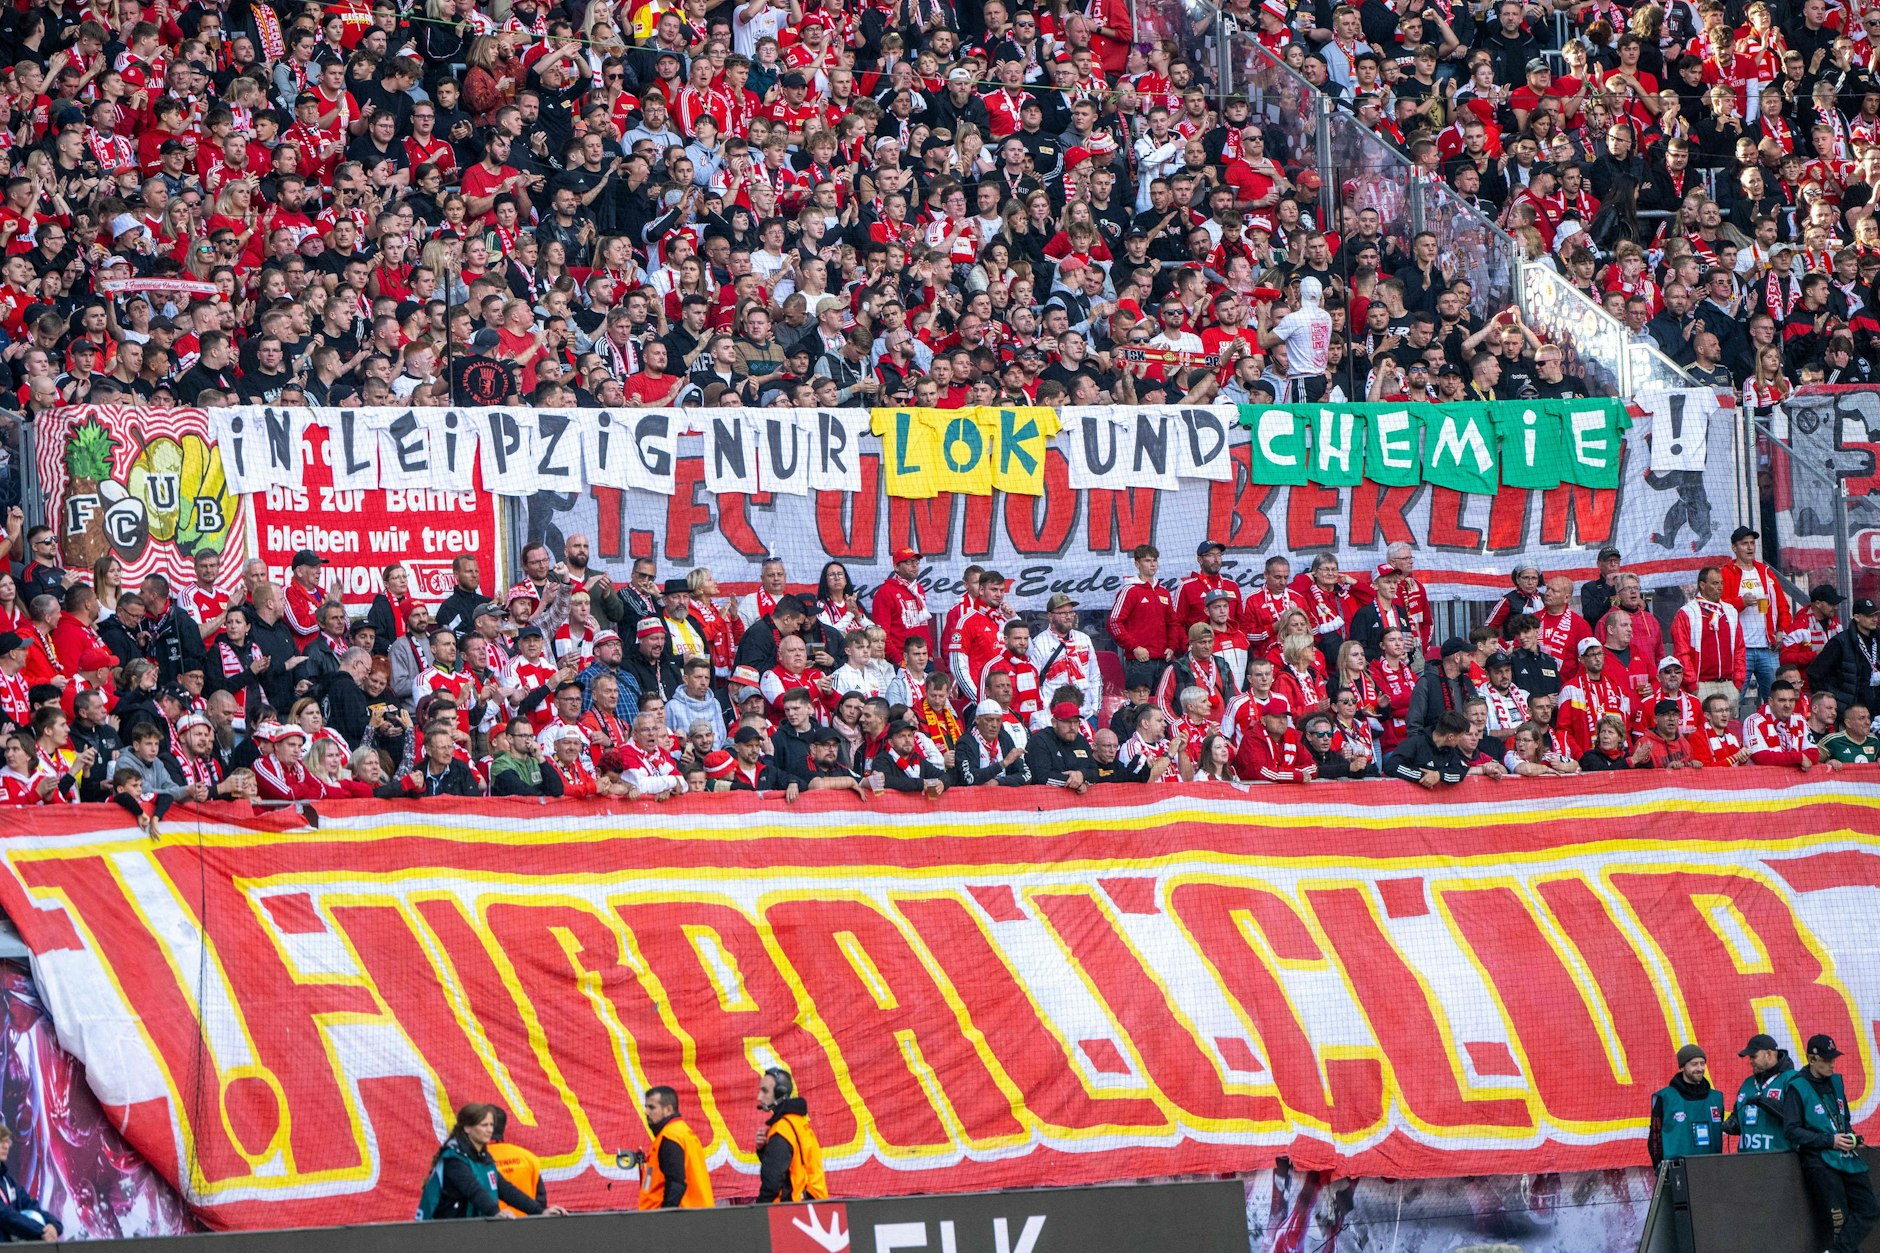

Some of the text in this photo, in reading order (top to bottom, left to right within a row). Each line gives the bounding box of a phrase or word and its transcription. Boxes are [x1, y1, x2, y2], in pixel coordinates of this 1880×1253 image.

[712, 411, 848, 480] NUR
[895, 410, 1040, 476] LOK
[1081, 409, 1226, 475] UND
[266, 484, 309, 512] bis
[320, 486, 365, 512] zur
[815, 447, 1160, 565] UNION
[1207, 440, 1632, 555] BERLIN
[267, 525, 480, 553] bleiben wir treu
[319, 566, 386, 595] NION
[1015, 563, 1123, 597] Ende
